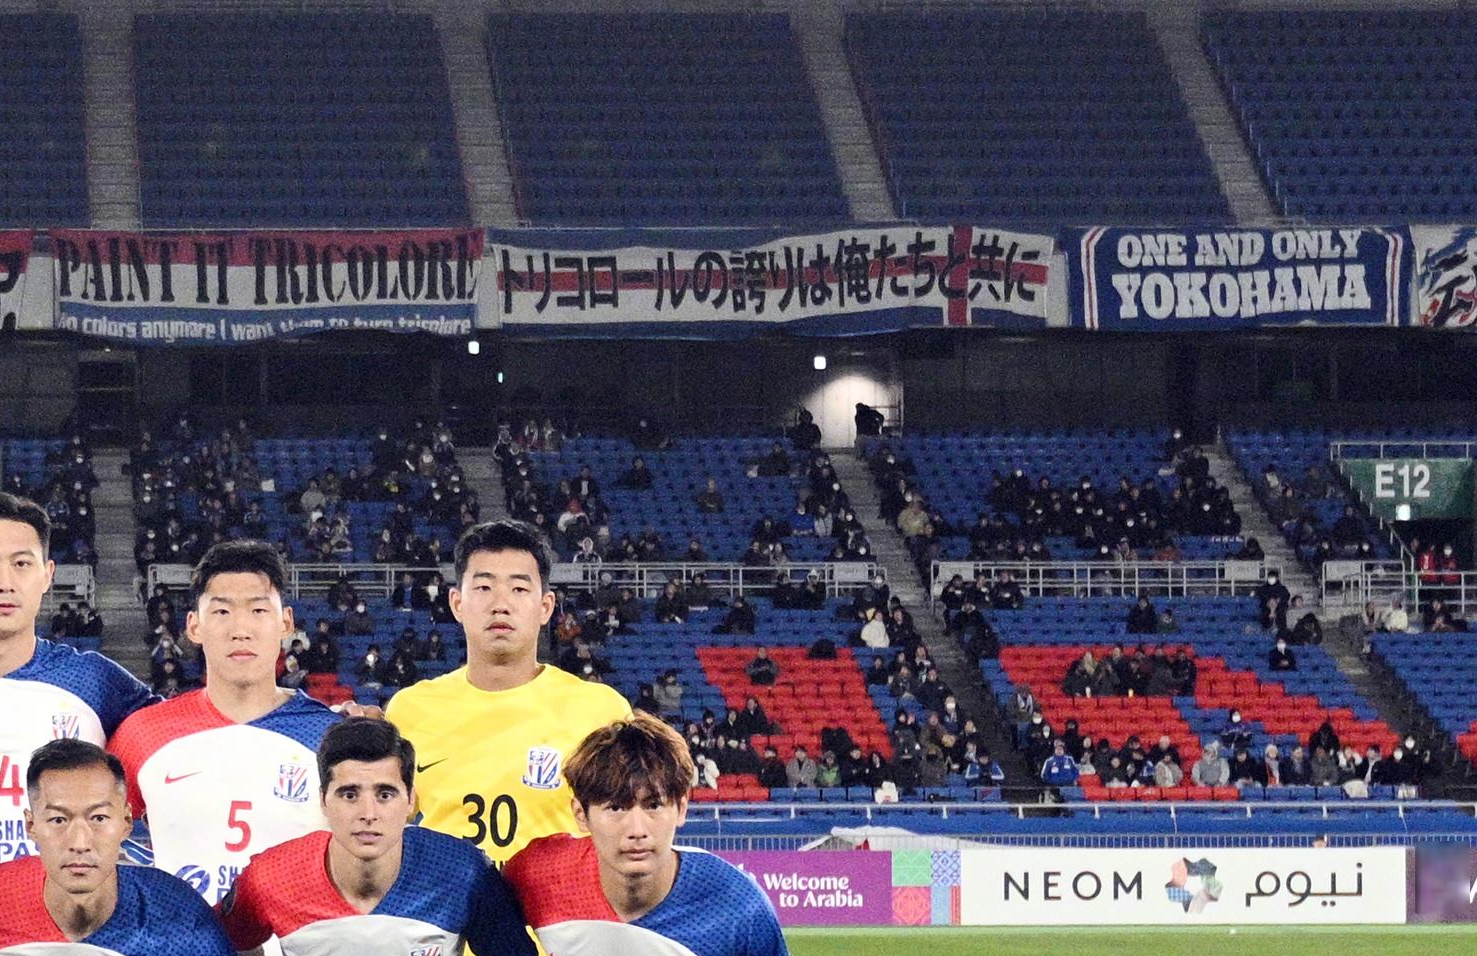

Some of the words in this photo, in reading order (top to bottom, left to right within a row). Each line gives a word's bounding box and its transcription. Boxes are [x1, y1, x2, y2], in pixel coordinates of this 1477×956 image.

[55, 236, 176, 302] PAINT
[193, 238, 235, 305] IT
[249, 230, 481, 305] TRICOLORE
[1117, 233, 1187, 268] ONE
[1195, 233, 1265, 266] AND
[1272, 229, 1363, 260] ONLY
[499, 230, 1042, 315] トリコロールの誇りは俺たちと共に
[1111, 263, 1372, 320] YOKOHAMA
[82, 315, 137, 338] colors
[141, 319, 217, 343] anymore
[1375, 464, 1430, 498] E12
[224, 800, 253, 852] 5
[462, 793, 518, 847] 30
[763, 873, 849, 891] Welcome
[779, 892, 799, 907] to
[803, 889, 864, 908] Arabia
[1004, 870, 1144, 901] NEOM
[1246, 863, 1364, 908] نيوم
